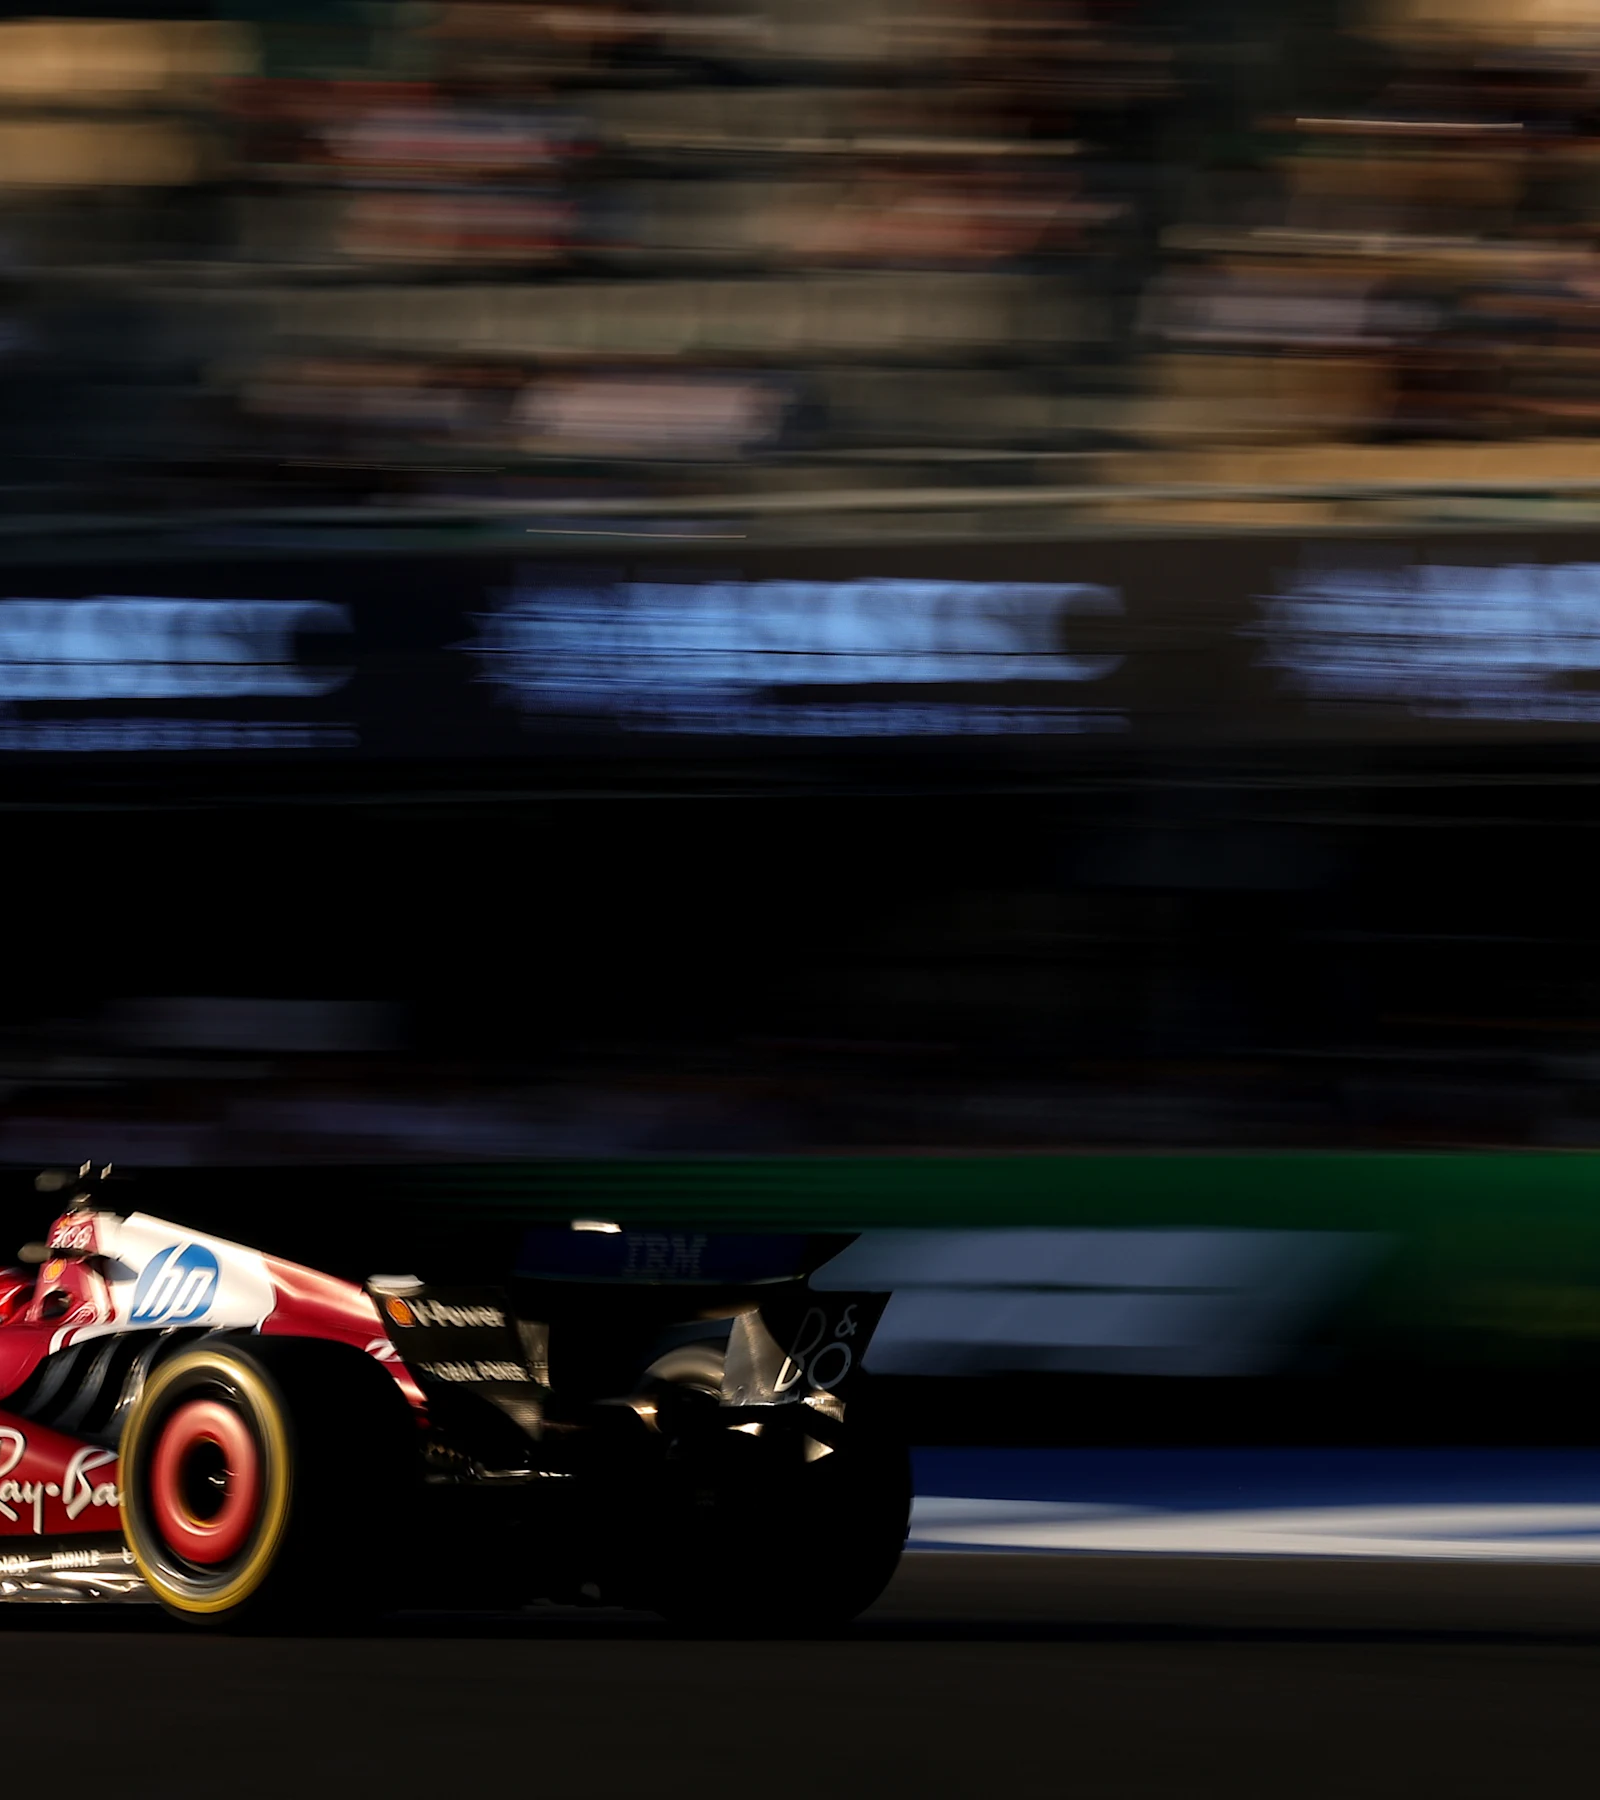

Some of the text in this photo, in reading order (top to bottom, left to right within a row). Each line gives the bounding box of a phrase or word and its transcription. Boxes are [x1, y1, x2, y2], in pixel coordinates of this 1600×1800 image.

[621, 1232, 708, 1278] IBM
[132, 1242, 218, 1325] hp
[404, 1299, 507, 1328] V-Power
